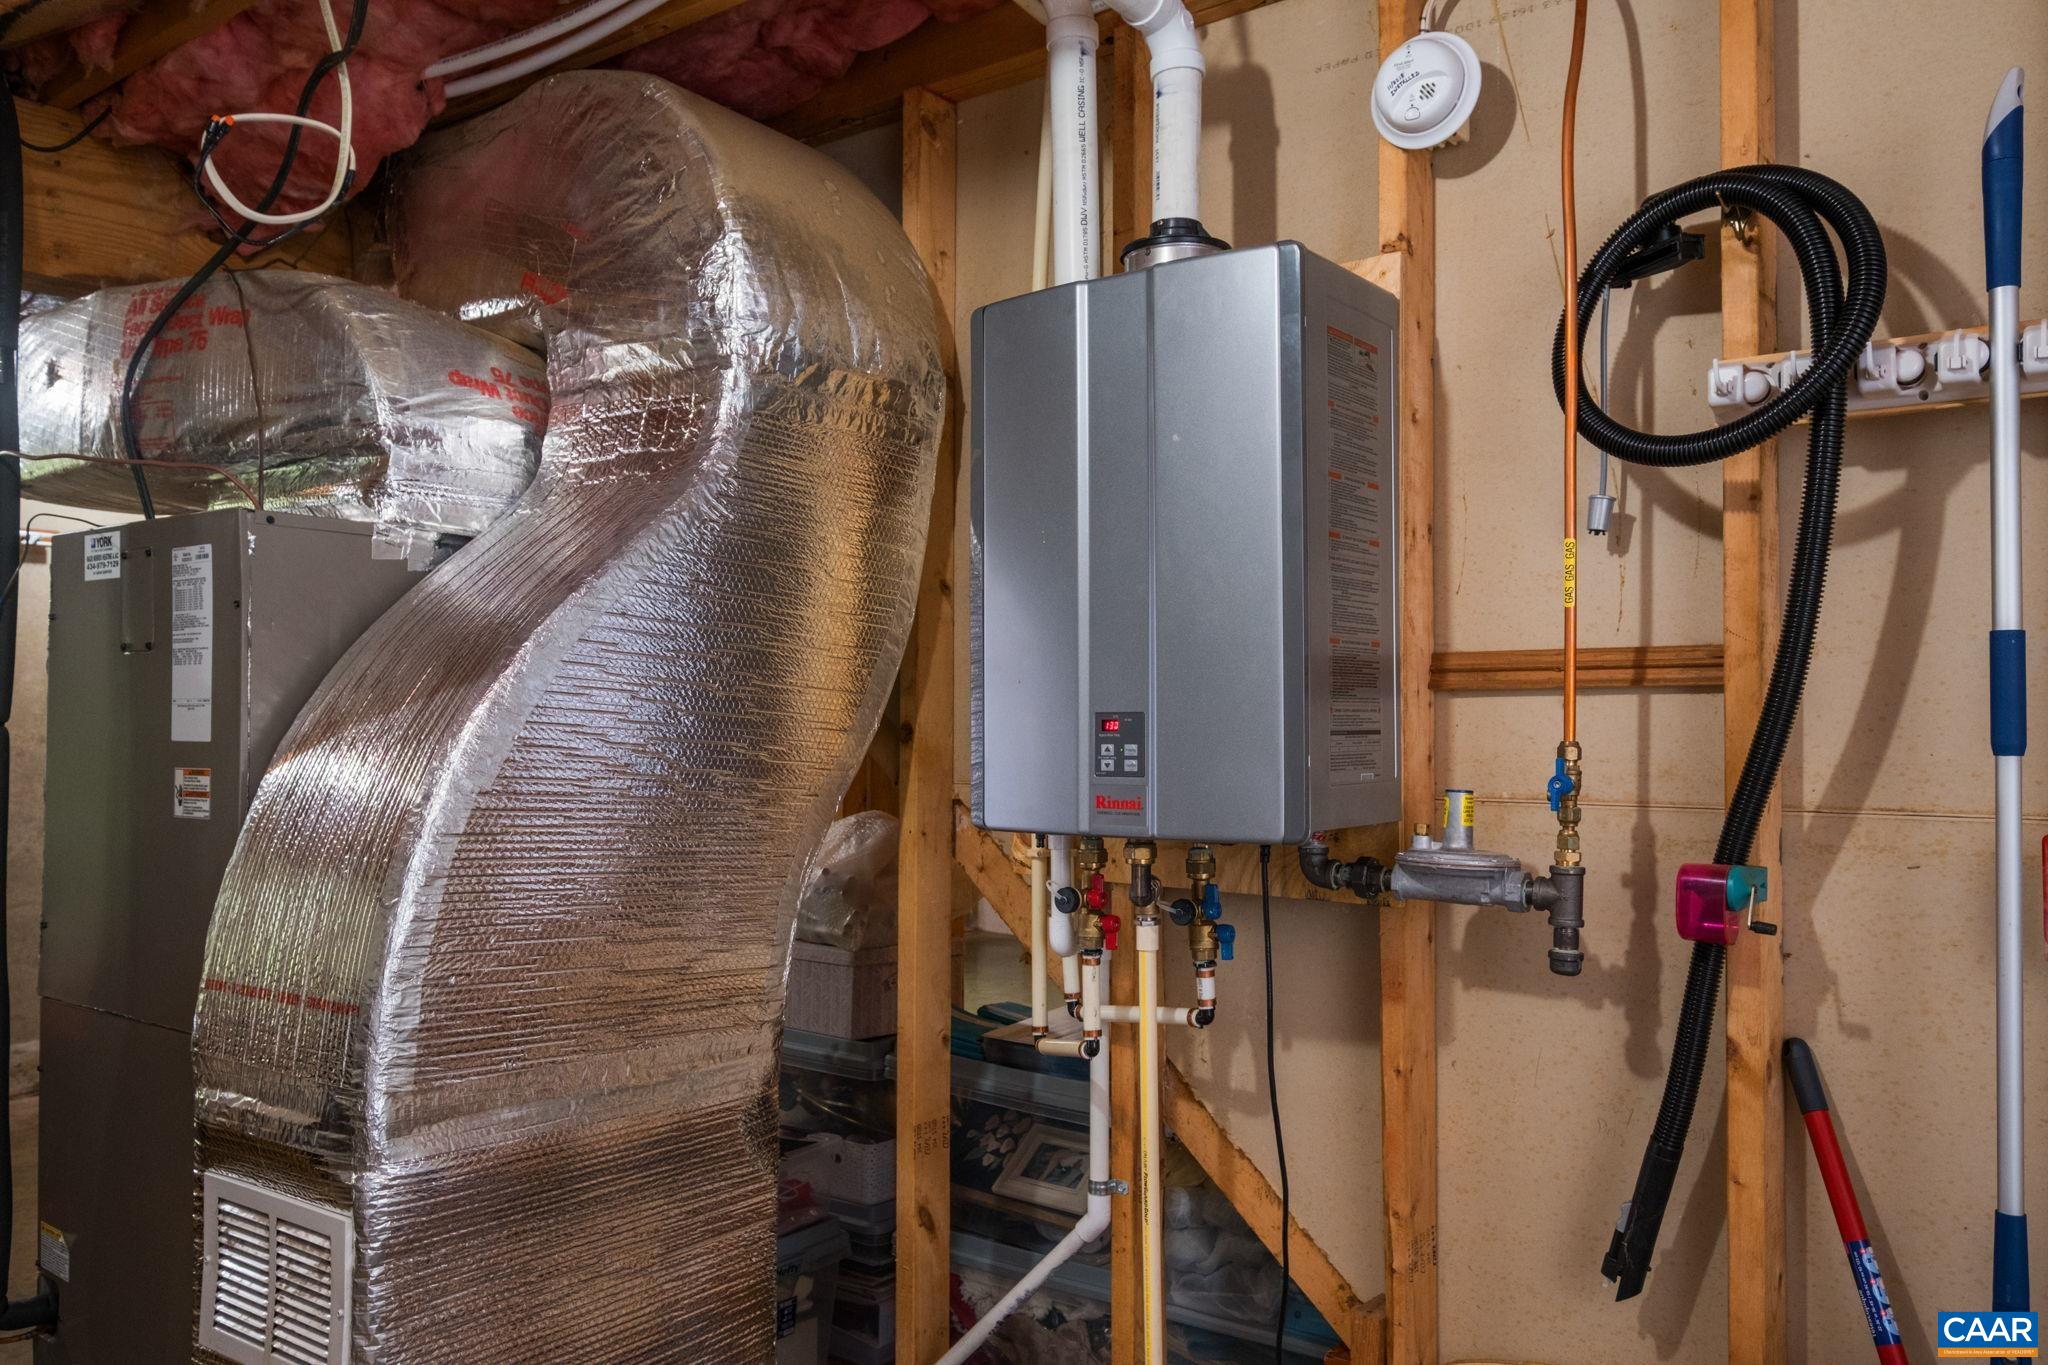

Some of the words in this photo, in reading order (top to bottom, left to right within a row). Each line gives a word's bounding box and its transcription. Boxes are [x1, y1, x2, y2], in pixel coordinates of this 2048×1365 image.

[1077, 85, 1086, 118] CASING
[1078, 121, 1086, 143] WELL
[1080, 207, 1088, 226] DWV
[208, 305, 252, 329] Wrap
[96, 535, 113, 549] YORK
[1564, 541, 1575, 560] GAS
[1564, 564, 1575, 582] GAS
[1564, 586, 1574, 604] GAS
[1104, 721, 1119, 730] 130
[1095, 794, 1143, 810] Rinnai
